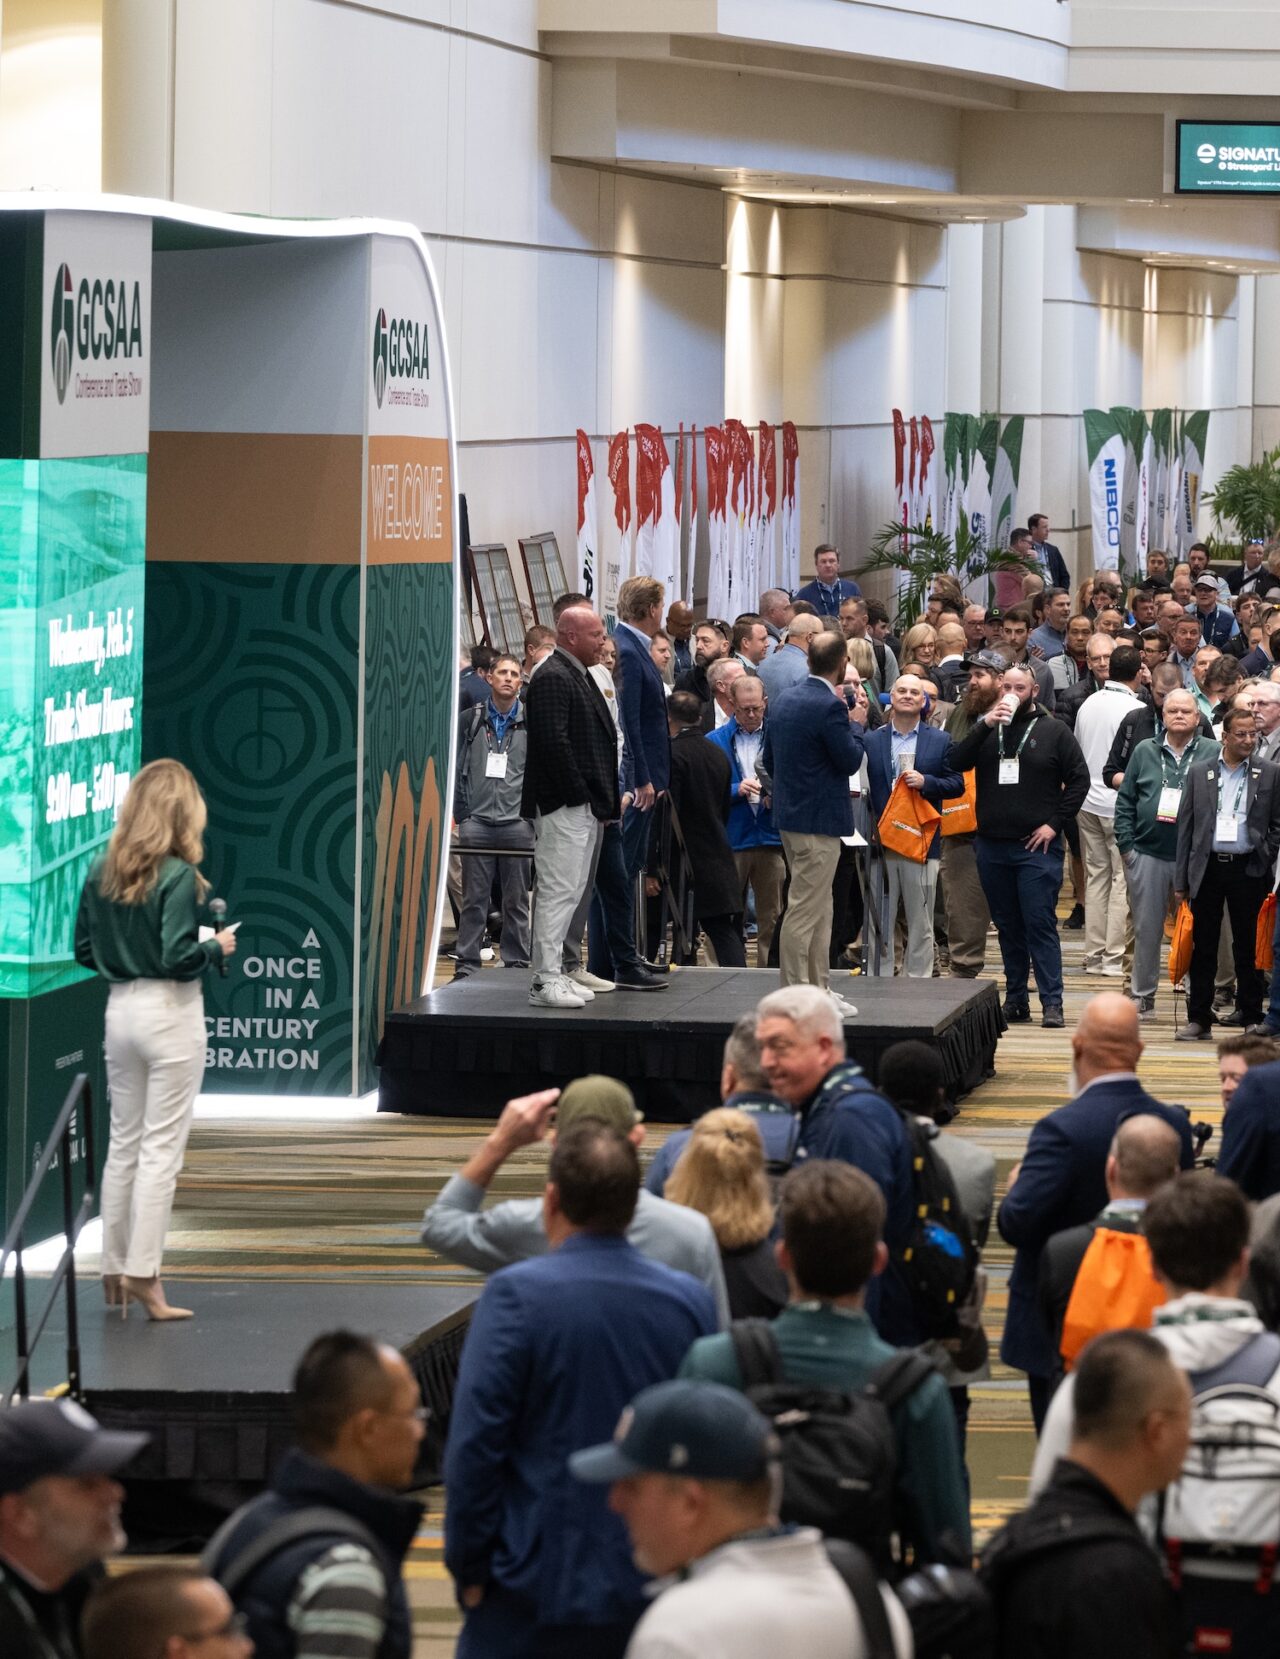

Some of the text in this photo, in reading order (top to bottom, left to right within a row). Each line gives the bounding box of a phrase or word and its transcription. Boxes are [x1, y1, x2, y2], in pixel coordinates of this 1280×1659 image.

[76, 278, 143, 361] GCSAA
[388, 318, 430, 380] GCSAA
[370, 462, 443, 542] WELCOME
[1104, 459, 1120, 546] NIBCO
[301, 927, 321, 948] A
[243, 956, 321, 979] ONCE
[265, 988, 320, 1009] IN A
[204, 1016, 320, 1039] CENTURY
[205, 1047, 319, 1070] BRATION
